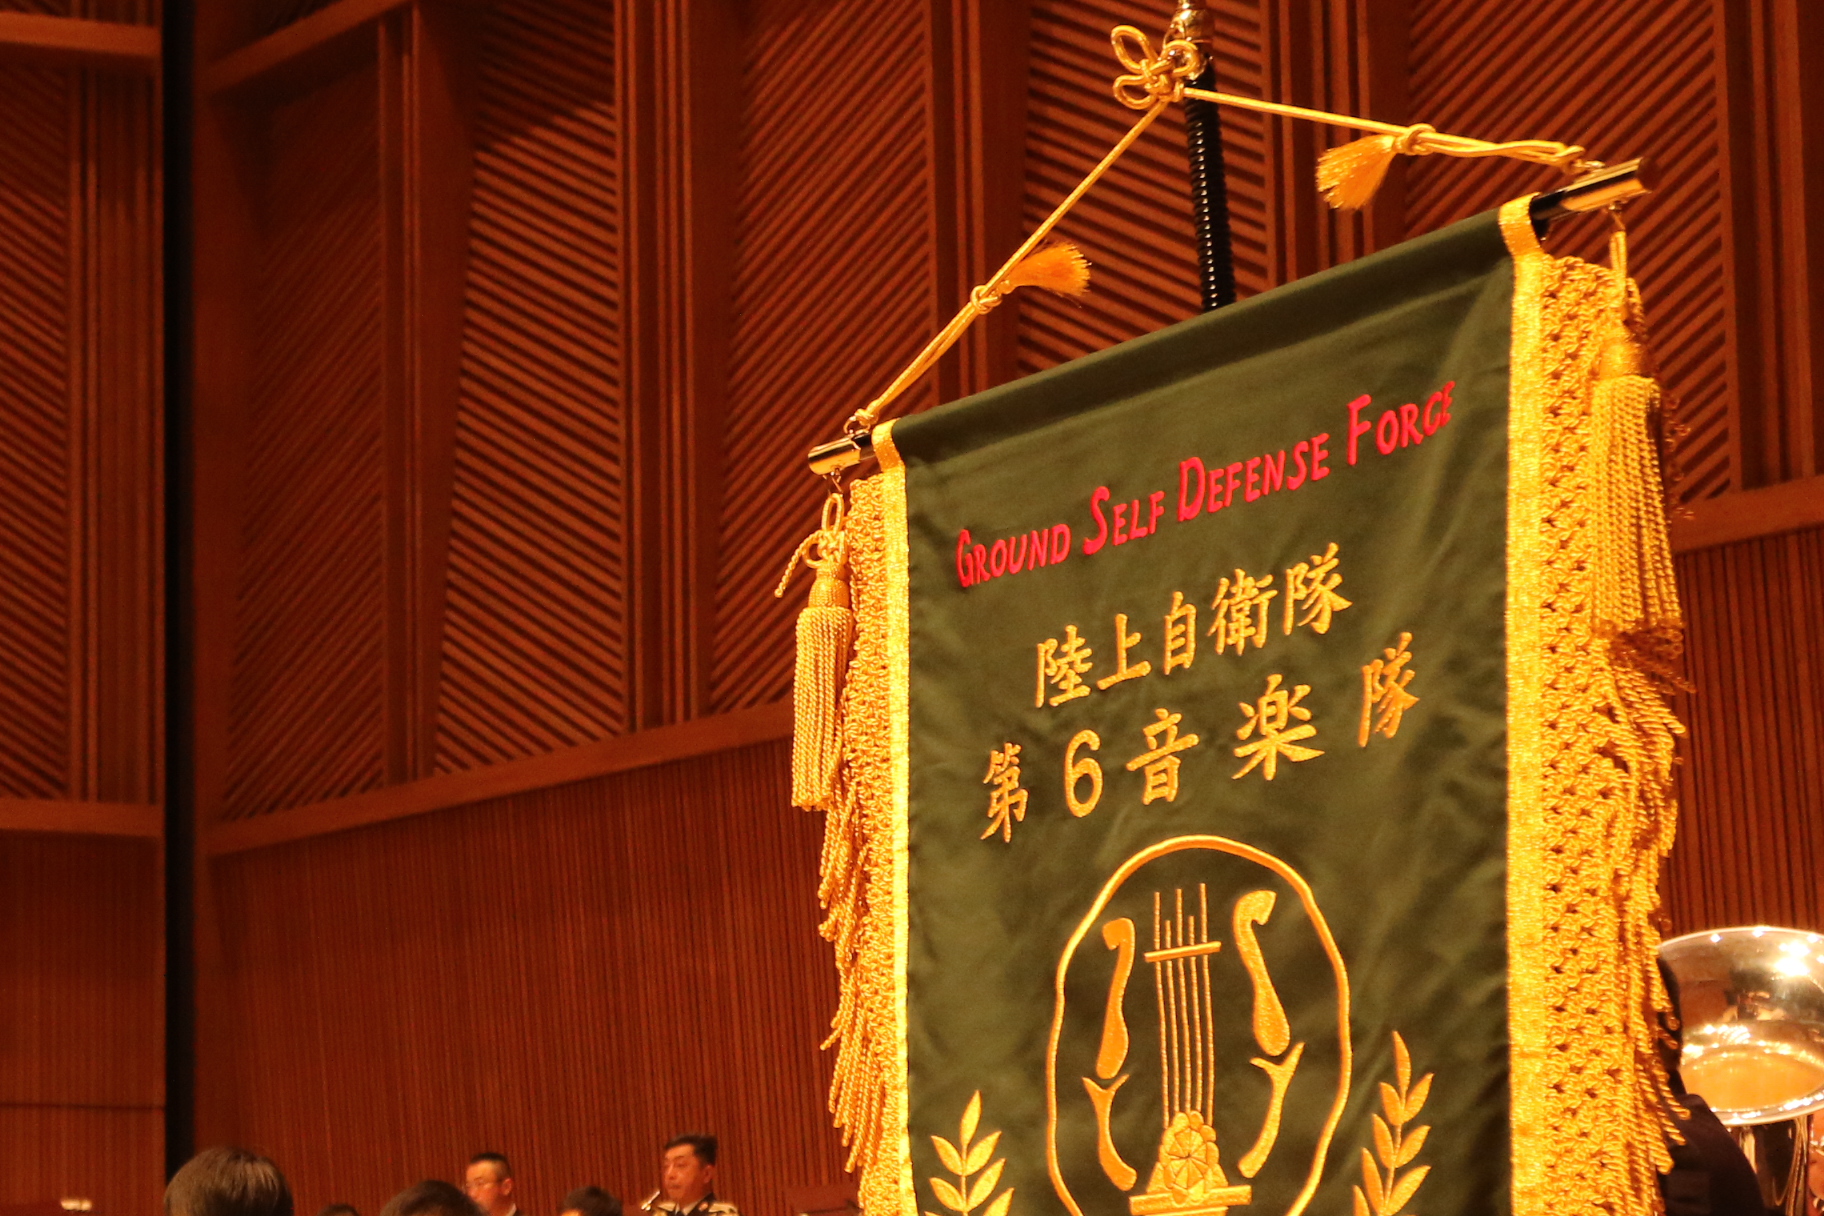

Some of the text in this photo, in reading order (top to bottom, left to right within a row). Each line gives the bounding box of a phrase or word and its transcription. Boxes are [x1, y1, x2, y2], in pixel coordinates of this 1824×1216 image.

[955, 522, 1073, 588] GROUND
[1081, 485, 1167, 556] SELF
[1175, 432, 1331, 523] DEFENSE
[1033, 541, 1353, 709] 陸上自衛隊
